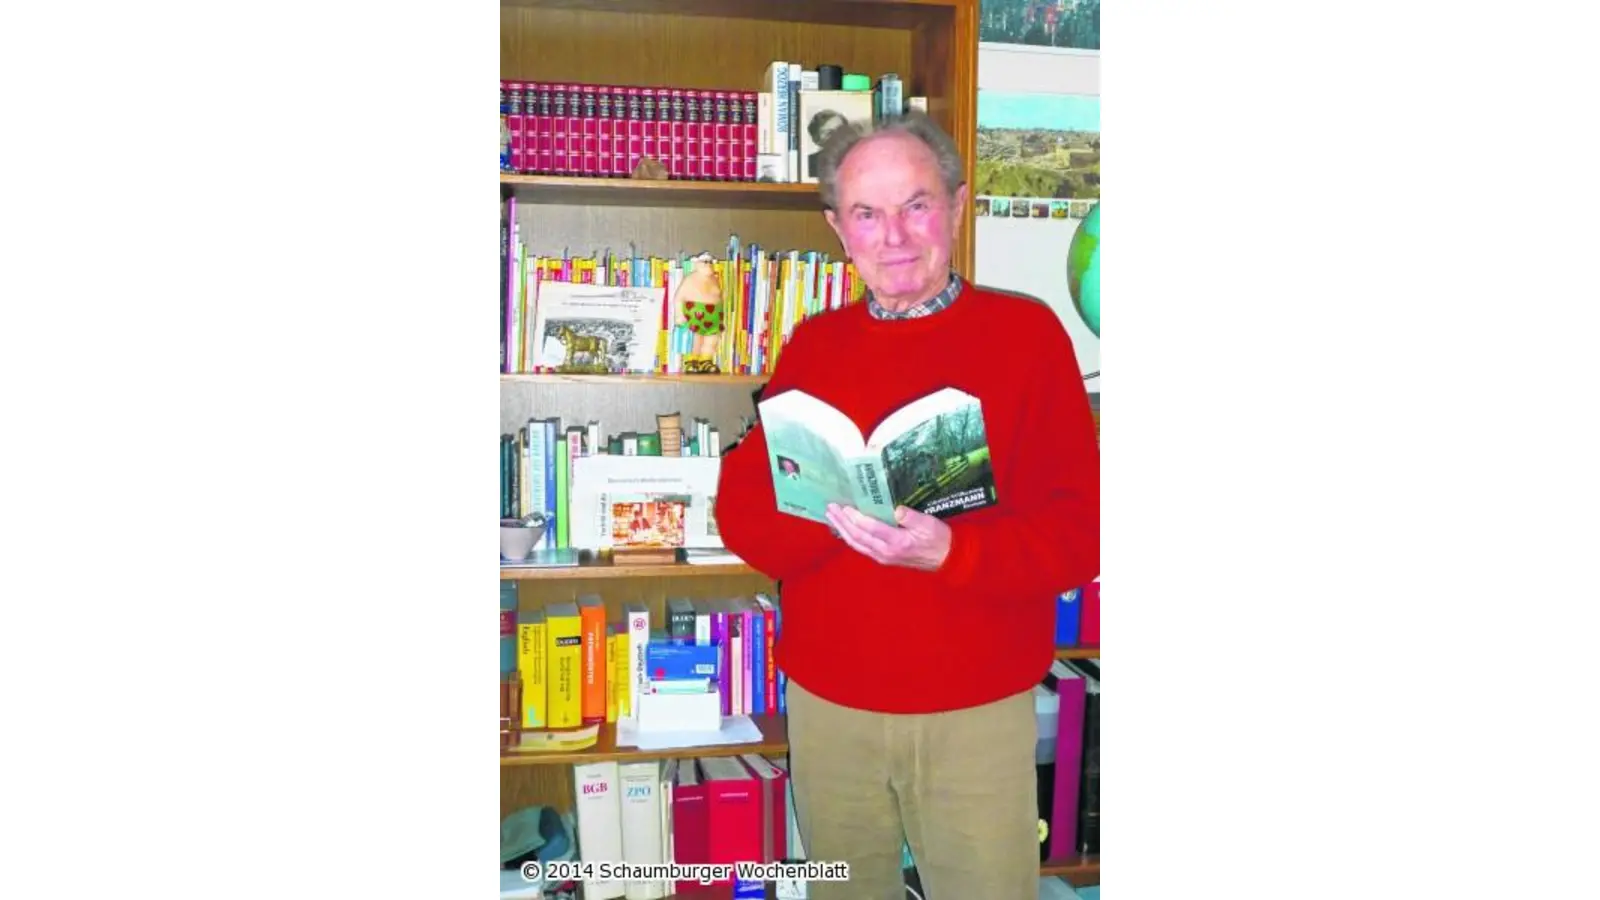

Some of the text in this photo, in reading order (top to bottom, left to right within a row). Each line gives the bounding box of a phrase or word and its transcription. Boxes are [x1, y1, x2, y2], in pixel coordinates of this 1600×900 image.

[776, 66, 788, 132] ROMAN HERZOG
[583, 783, 608, 795] BGB
[626, 786, 651, 798] ZPO
